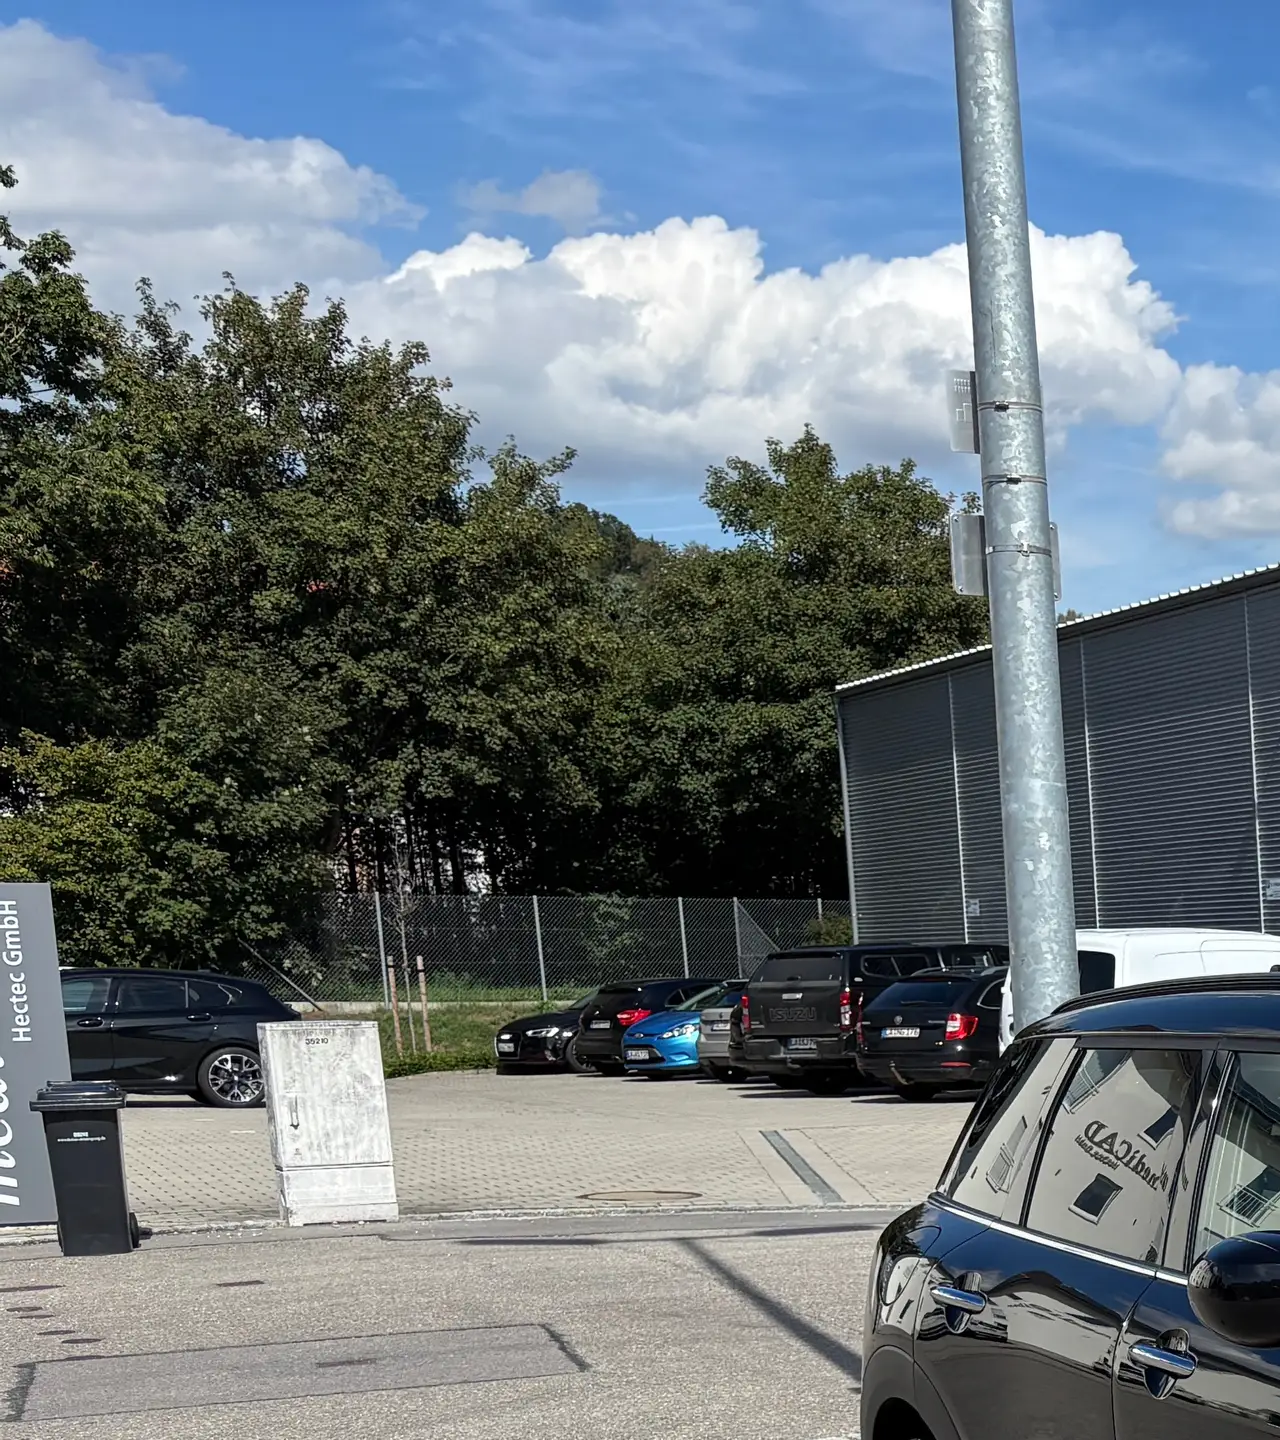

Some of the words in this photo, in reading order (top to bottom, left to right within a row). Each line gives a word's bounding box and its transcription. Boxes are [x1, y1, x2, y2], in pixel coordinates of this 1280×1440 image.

[0, 900, 23, 966] GmbH
[9, 972, 33, 1042] Hectec
[768, 1006, 817, 1022] ISUZU
